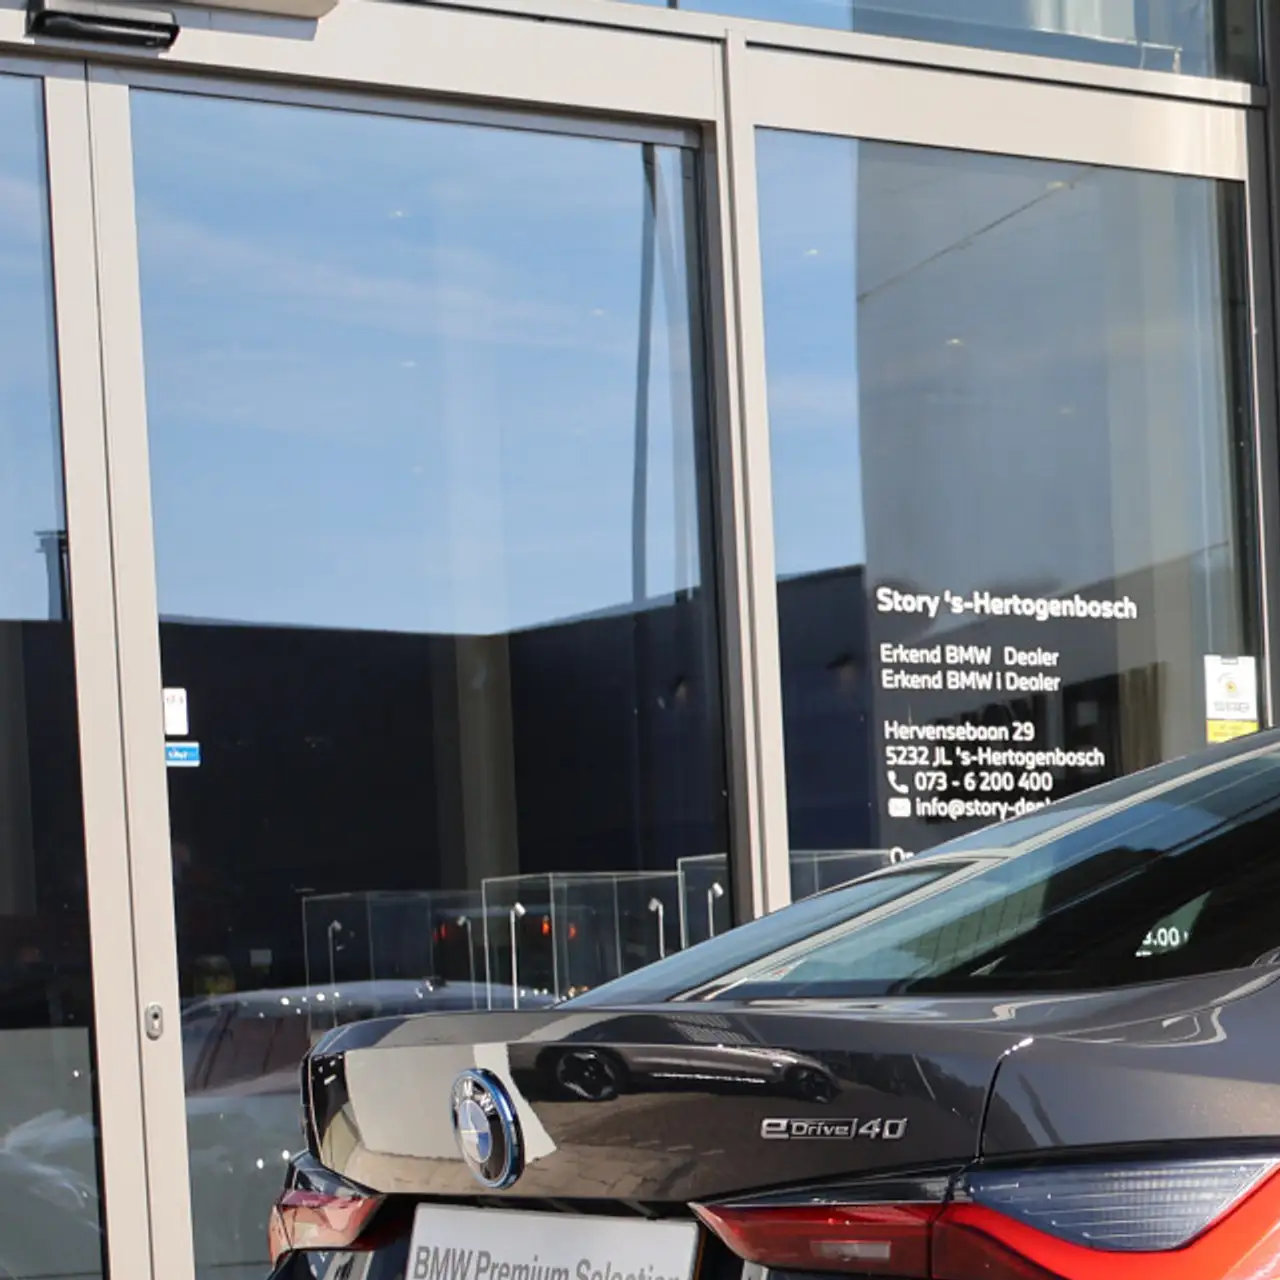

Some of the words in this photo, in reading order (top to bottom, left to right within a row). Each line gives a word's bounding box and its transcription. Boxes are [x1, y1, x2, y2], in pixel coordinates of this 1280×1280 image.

[876, 587, 939, 617] Story
[880, 643, 941, 664] Erkend
[945, 645, 992, 665] BMW
[1004, 646, 1059, 666] Dealer
[881, 669, 942, 689] Erkend
[946, 670, 992, 690] BMW
[996, 671, 1002, 690] i
[1005, 672, 1061, 691] Dealer
[884, 720, 1009, 741] Hervensebaan
[1012, 721, 1035, 742] 29
[886, 746, 929, 766] 5232
[932, 747, 953, 766] JL
[914, 772, 947, 791] 073
[964, 772, 975, 791] 6
[979, 772, 1014, 791] 200
[1017, 772, 1053, 791] 400
[916, 797, 1051, 821] info@story-de
